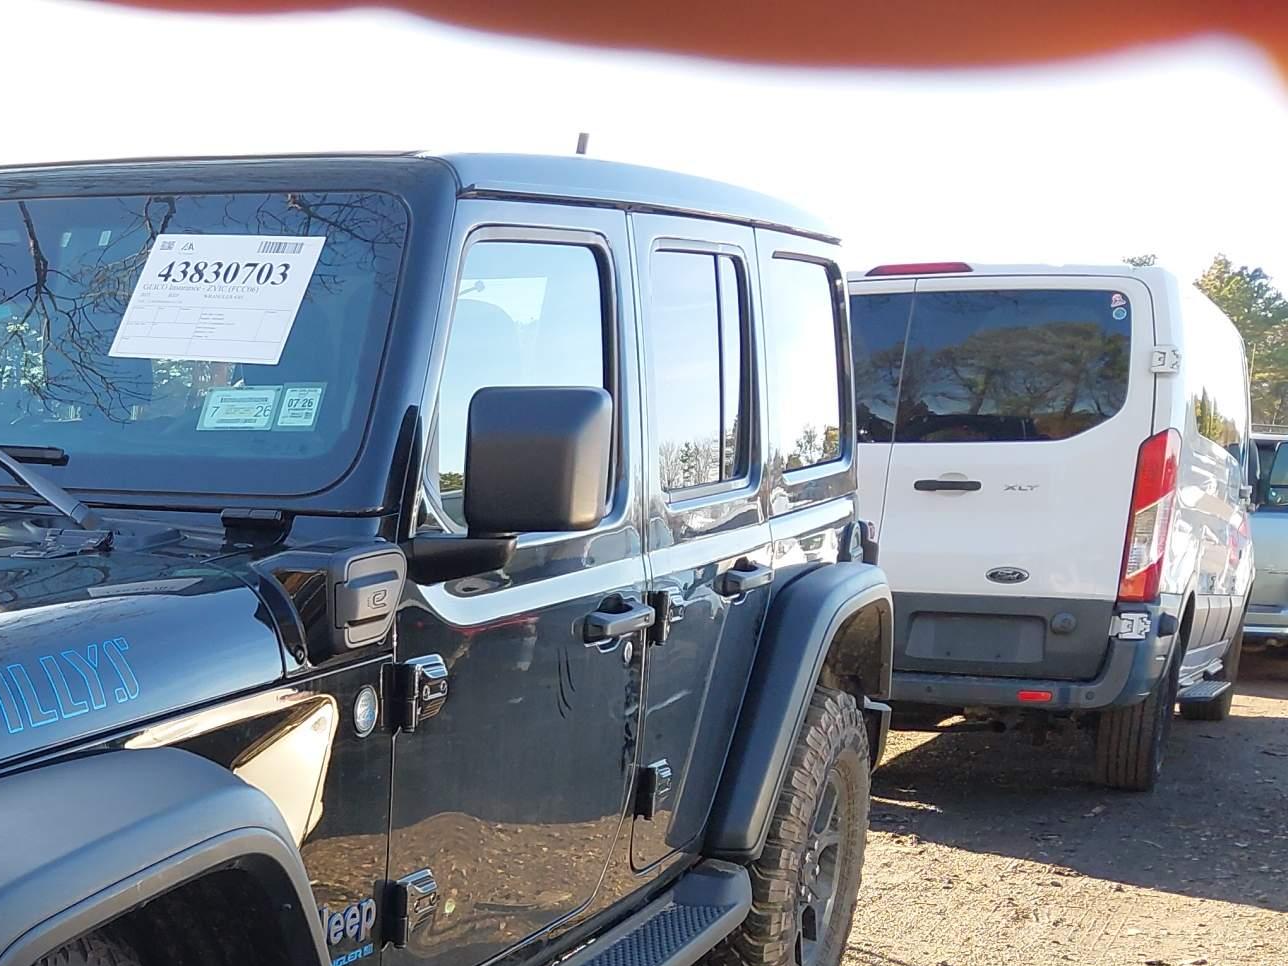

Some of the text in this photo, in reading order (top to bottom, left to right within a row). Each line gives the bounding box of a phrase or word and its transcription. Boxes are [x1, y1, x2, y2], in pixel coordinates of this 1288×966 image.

[158, 261, 290, 285] 43830703
[210, 406, 221, 418] 7
[1003, 483, 1040, 492] XLT
